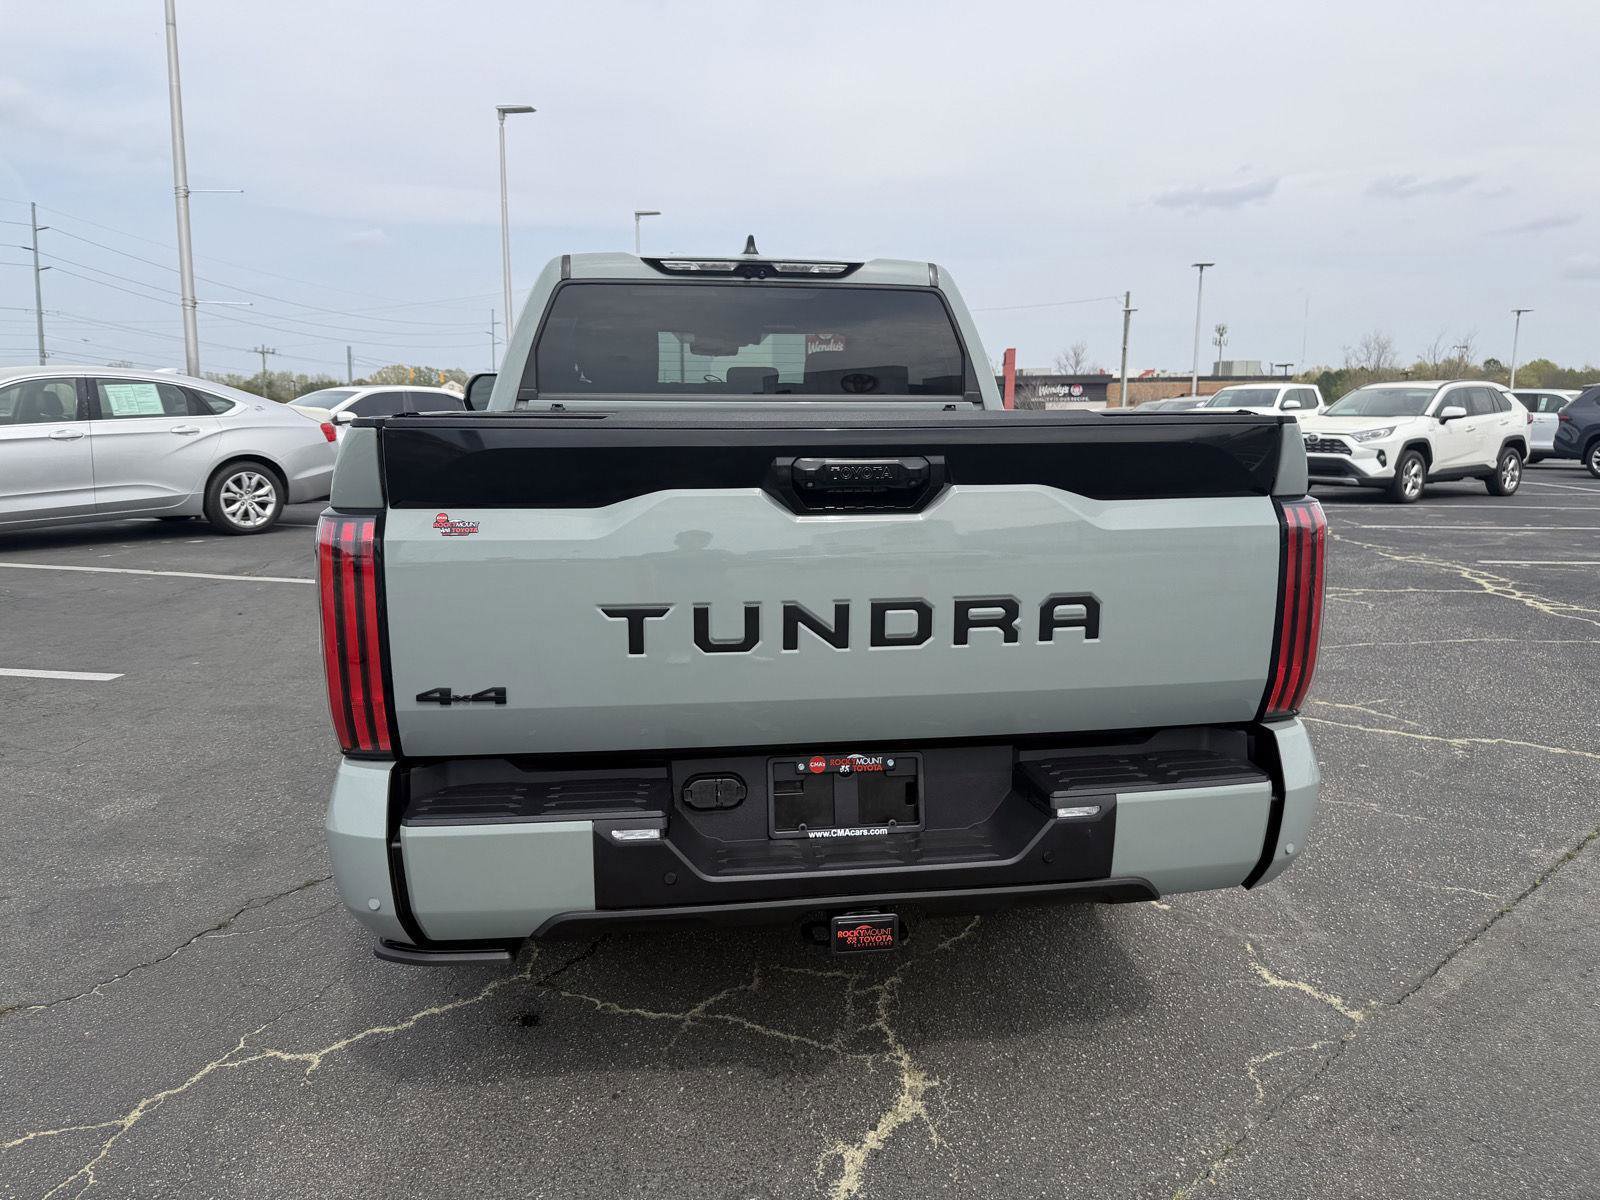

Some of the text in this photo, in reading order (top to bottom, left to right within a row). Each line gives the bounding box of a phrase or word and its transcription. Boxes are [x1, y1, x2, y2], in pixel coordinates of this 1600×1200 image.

[1038, 384, 1070, 396] Wendy's
[830, 466, 893, 480] TOYOTA
[597, 593, 1103, 657] TUNDRA
[852, 764, 884, 773] TOYOTA
[808, 828, 888, 839] www.CMAcars.com
[859, 935, 893, 944] TOYOTA
